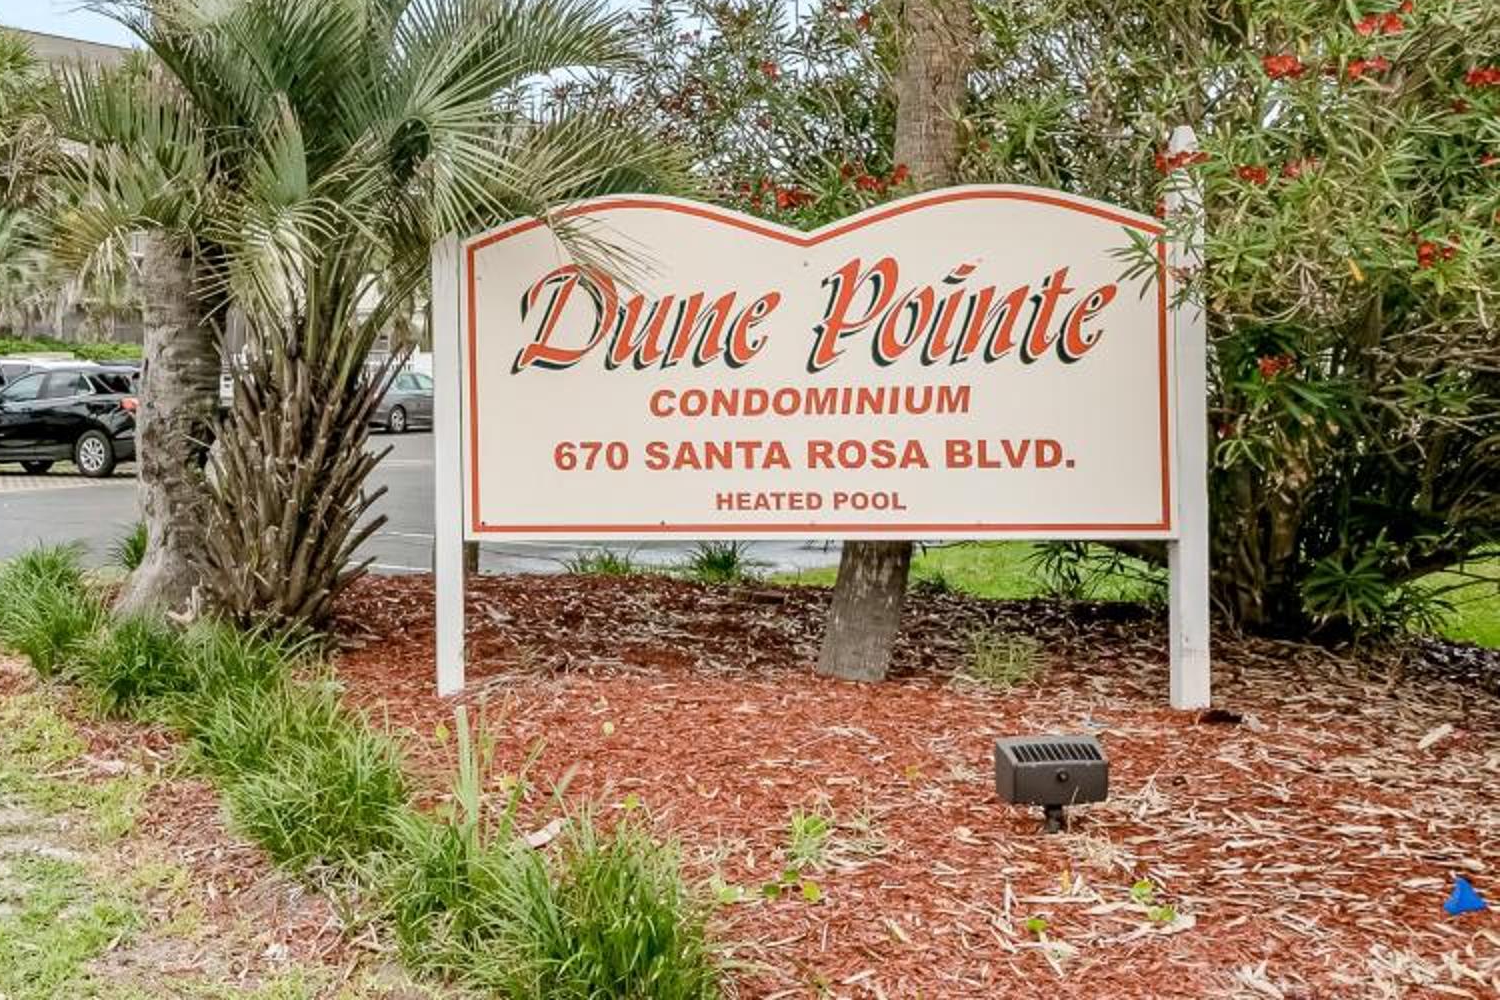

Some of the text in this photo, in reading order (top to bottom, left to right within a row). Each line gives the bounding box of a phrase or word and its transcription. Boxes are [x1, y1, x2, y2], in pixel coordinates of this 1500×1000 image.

[510, 256, 1118, 374] Dune Pointe
[649, 386, 971, 417] CONDOMINIUM
[554, 439, 1076, 471] 670 SANTA ROSA BLVD.
[716, 492, 907, 510] HEATED POOL
